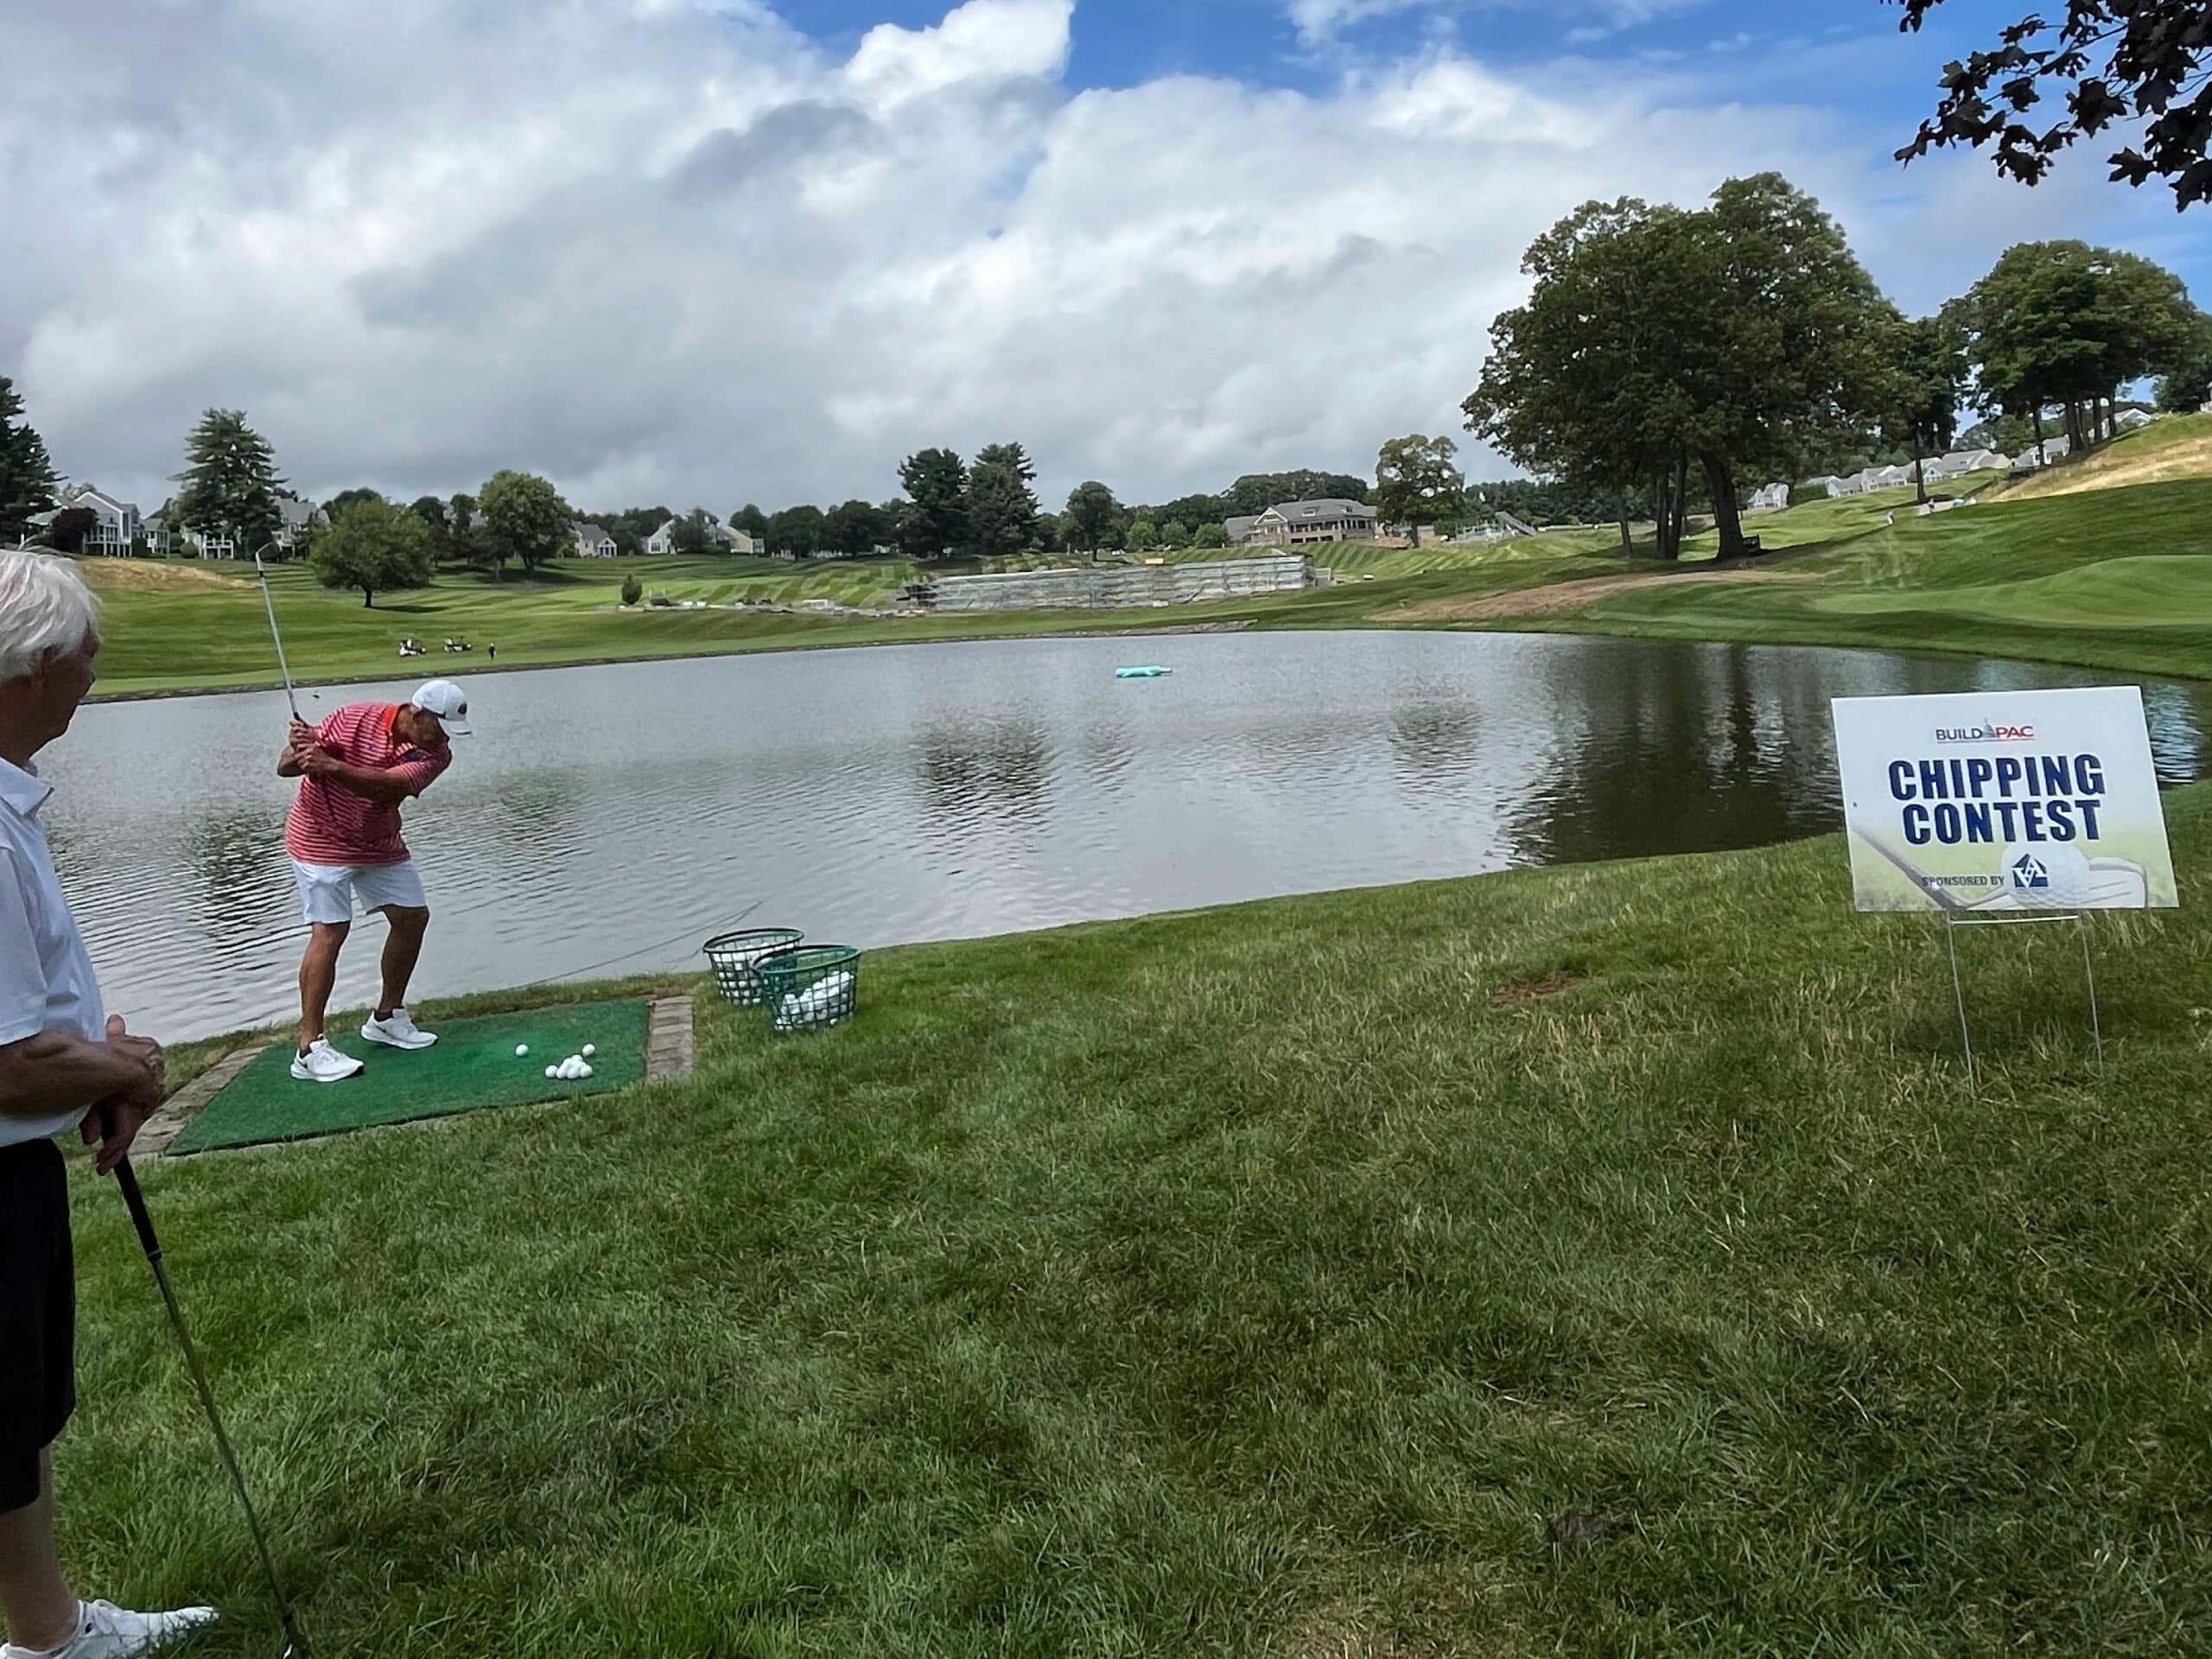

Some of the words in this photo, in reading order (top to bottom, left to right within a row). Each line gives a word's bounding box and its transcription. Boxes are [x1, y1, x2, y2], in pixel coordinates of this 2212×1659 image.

[1936, 728, 1983, 741] BUILD
[1995, 726, 2035, 738] PAC
[1888, 753, 2106, 800] CHIPPING
[1903, 799, 2101, 844] CONTEST
[1922, 875, 1987, 887] SPONSORED
[1990, 875, 2005, 886] BY
